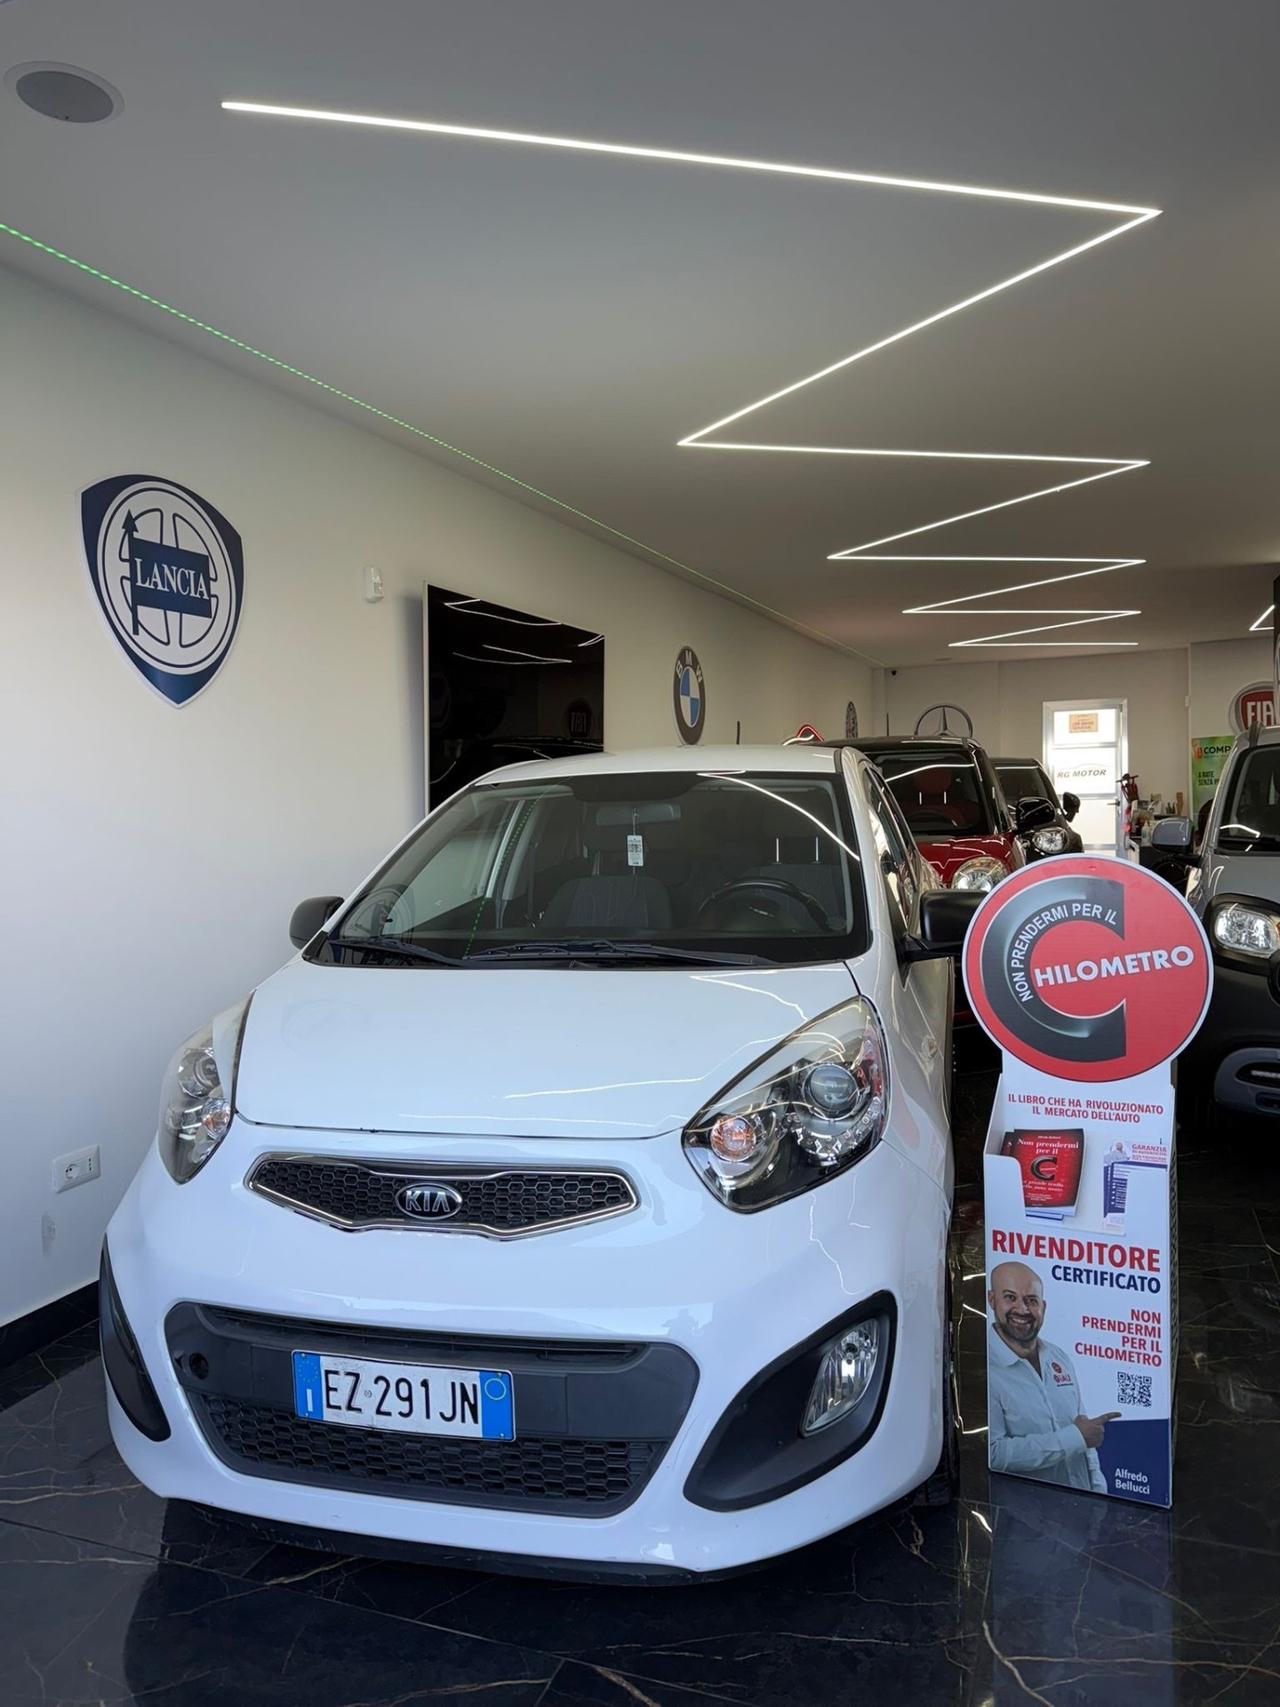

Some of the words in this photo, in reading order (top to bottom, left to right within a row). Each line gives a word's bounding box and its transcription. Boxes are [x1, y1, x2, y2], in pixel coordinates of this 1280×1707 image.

[135, 557, 210, 600] LANCIA
[676, 650, 703, 682] BMW
[1246, 701, 1275, 727] FIA
[1203, 745, 1232, 755] COMP
[1057, 771, 1070, 779] RG
[1072, 768, 1107, 778] MOTOR
[1072, 903, 1103, 919] PER
[1104, 908, 1117, 925] IL
[1011, 904, 1069, 969] PRENDERMI
[1034, 945, 1195, 988] HILOMETRO
[1011, 972, 1034, 1002] NON
[1008, 1093, 1018, 1103] IL
[1018, 1094, 1046, 1106] LIBRO
[1047, 1096, 1066, 1107] CHE
[1068, 1098, 1082, 1108] HA
[1086, 1099, 1164, 1115] RIVOLUZIONATO
[1032, 1105, 1041, 1115] IL
[1044, 1107, 1089, 1119] MERCATO
[1091, 1110, 1141, 1123] DELL'AUTO
[1018, 1138, 1034, 1146] Non
[1036, 1140, 1079, 1149] prendermi
[1052, 1147, 1059, 1155] il
[405, 1190, 451, 1213] KIA
[992, 1229, 1161, 1272] RIVENDITORE
[1051, 1264, 1161, 1294] CERTIFICATO
[1082, 1315, 1161, 1339] PRENDERMI
[1130, 1309, 1161, 1325] NON
[1075, 1342, 1162, 1367] CHILOMETRO
[1121, 1336, 1147, 1351] PER
[1150, 1340, 1162, 1353] IL
[324, 1370, 362, 1413] EZ
[1115, 1468, 1148, 1483] Alfredo
[1115, 1479, 1150, 1495] Bellucci
